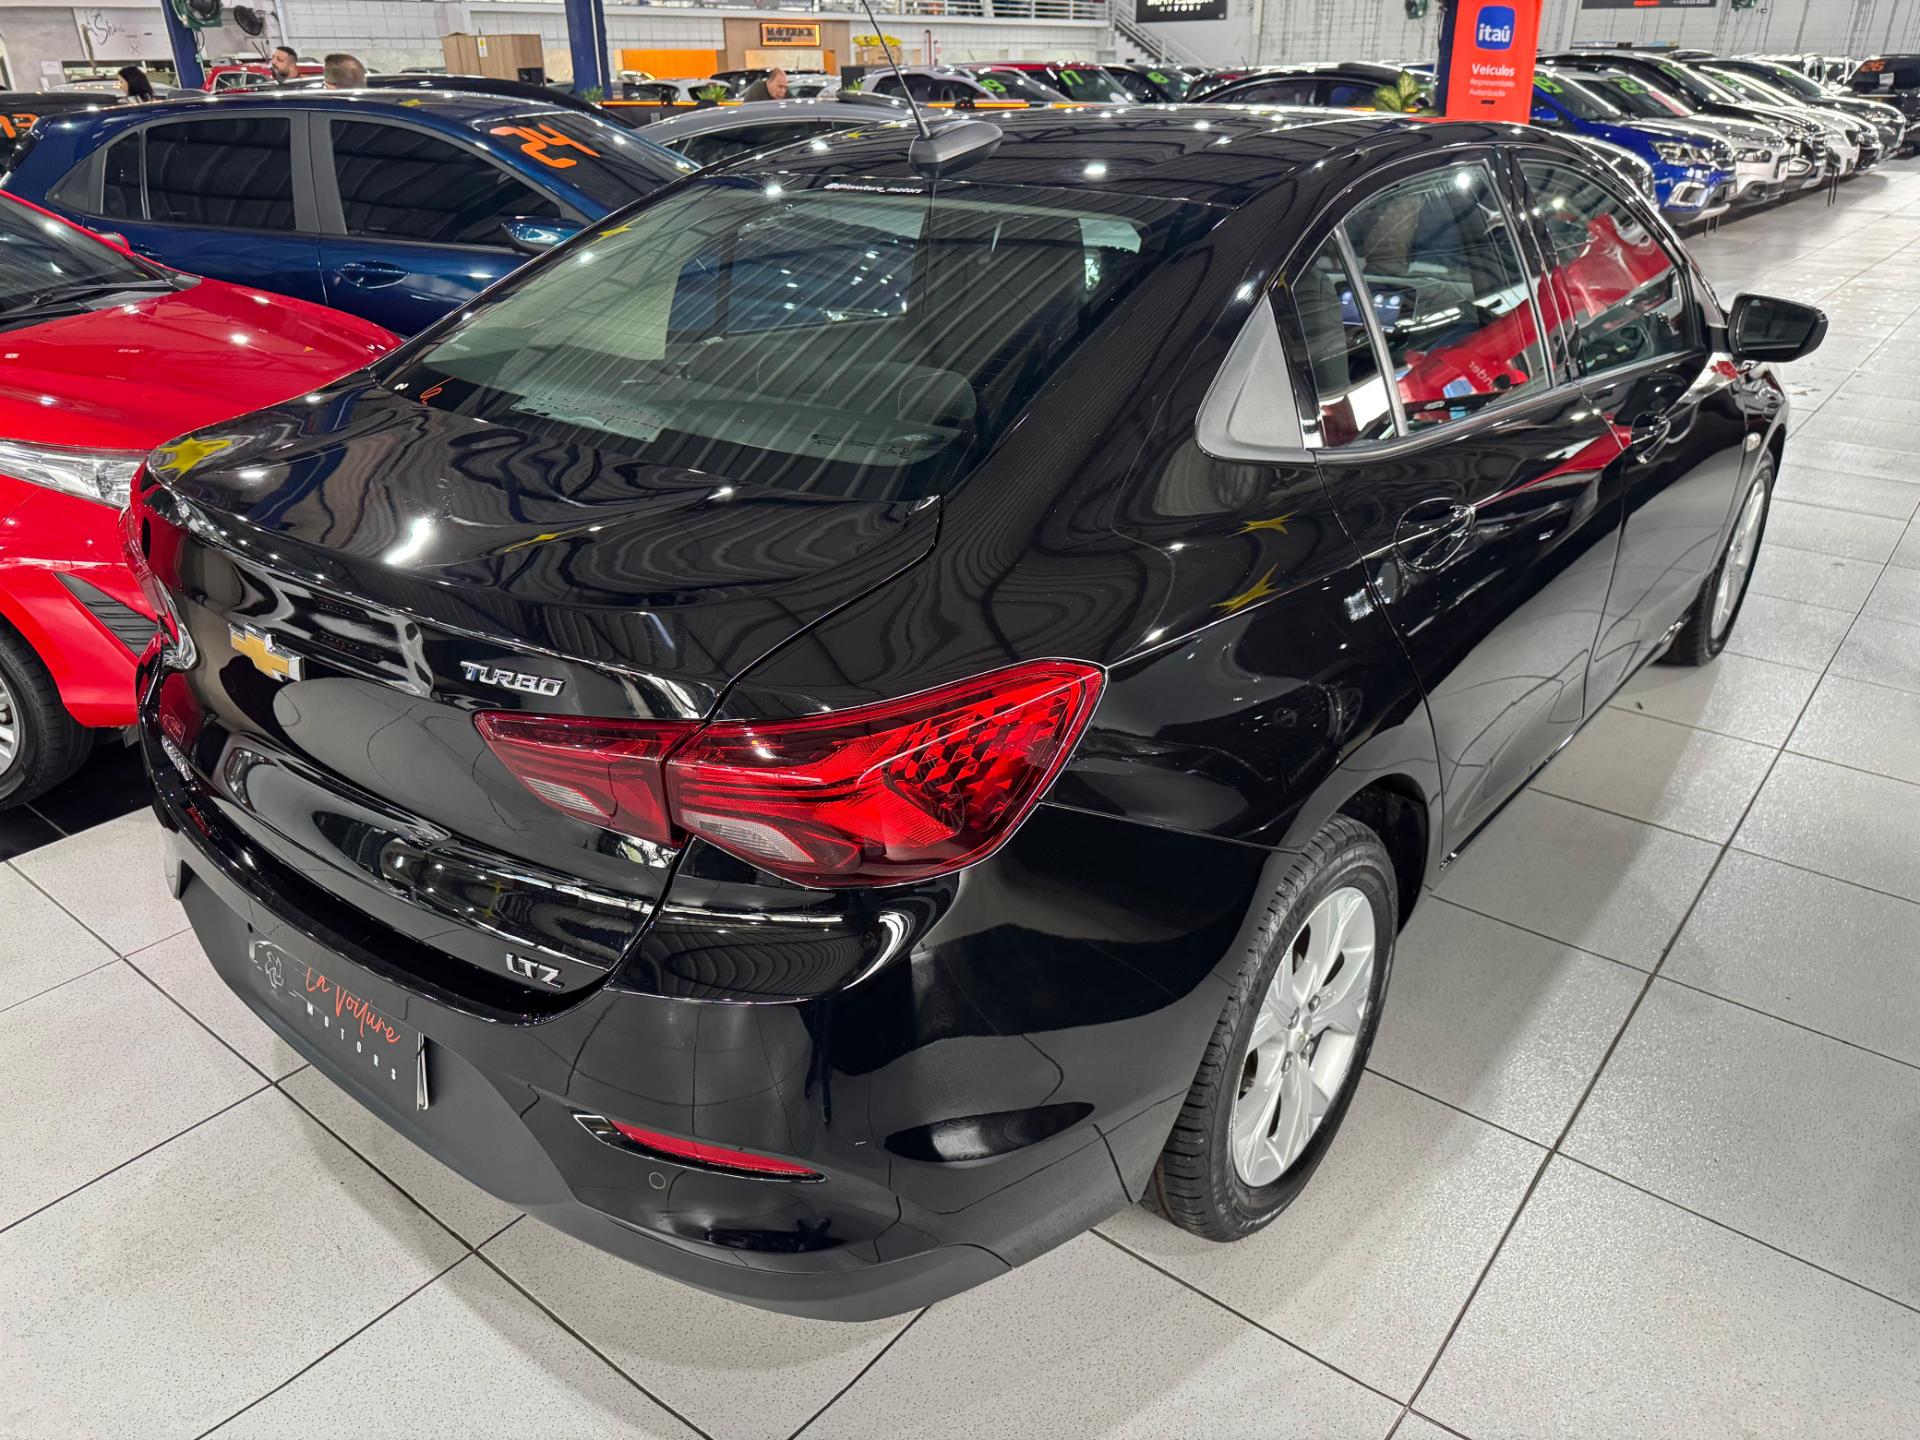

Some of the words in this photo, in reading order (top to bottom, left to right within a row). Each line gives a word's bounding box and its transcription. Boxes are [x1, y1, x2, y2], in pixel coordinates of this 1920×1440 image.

[1478, 23, 1511, 43] itaú
[1471, 63, 1516, 77] Veículos
[489, 123, 601, 169] 24
[459, 660, 565, 697] TURBO
[506, 952, 563, 988] LTZ
[305, 966, 331, 993] La
[334, 984, 401, 1044] Voiture
[306, 1001, 397, 1081] MOTORS
